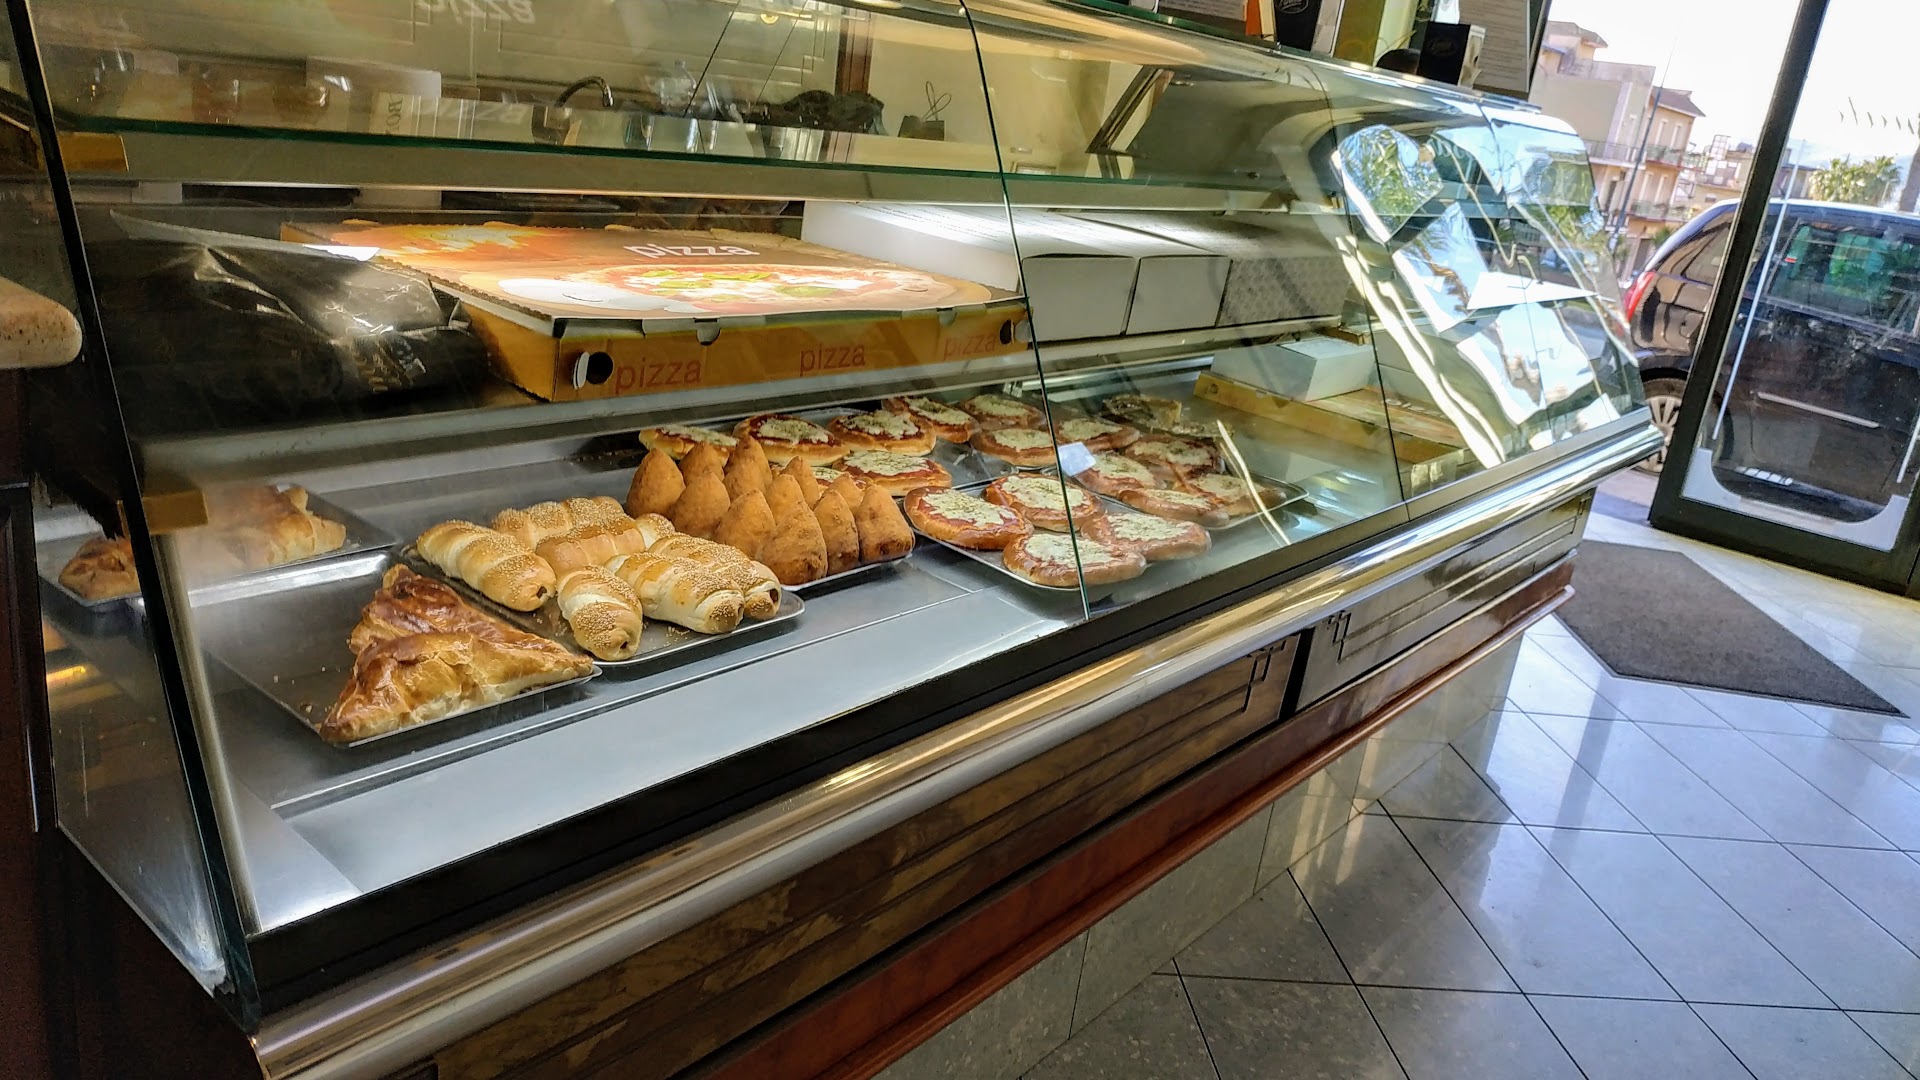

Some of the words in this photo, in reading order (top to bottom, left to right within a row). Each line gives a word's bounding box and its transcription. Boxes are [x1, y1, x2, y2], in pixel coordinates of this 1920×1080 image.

[623, 243, 760, 259] pizza
[614, 357, 702, 395] pizza
[799, 343, 866, 377] pizza
[944, 332, 998, 361] pizza
